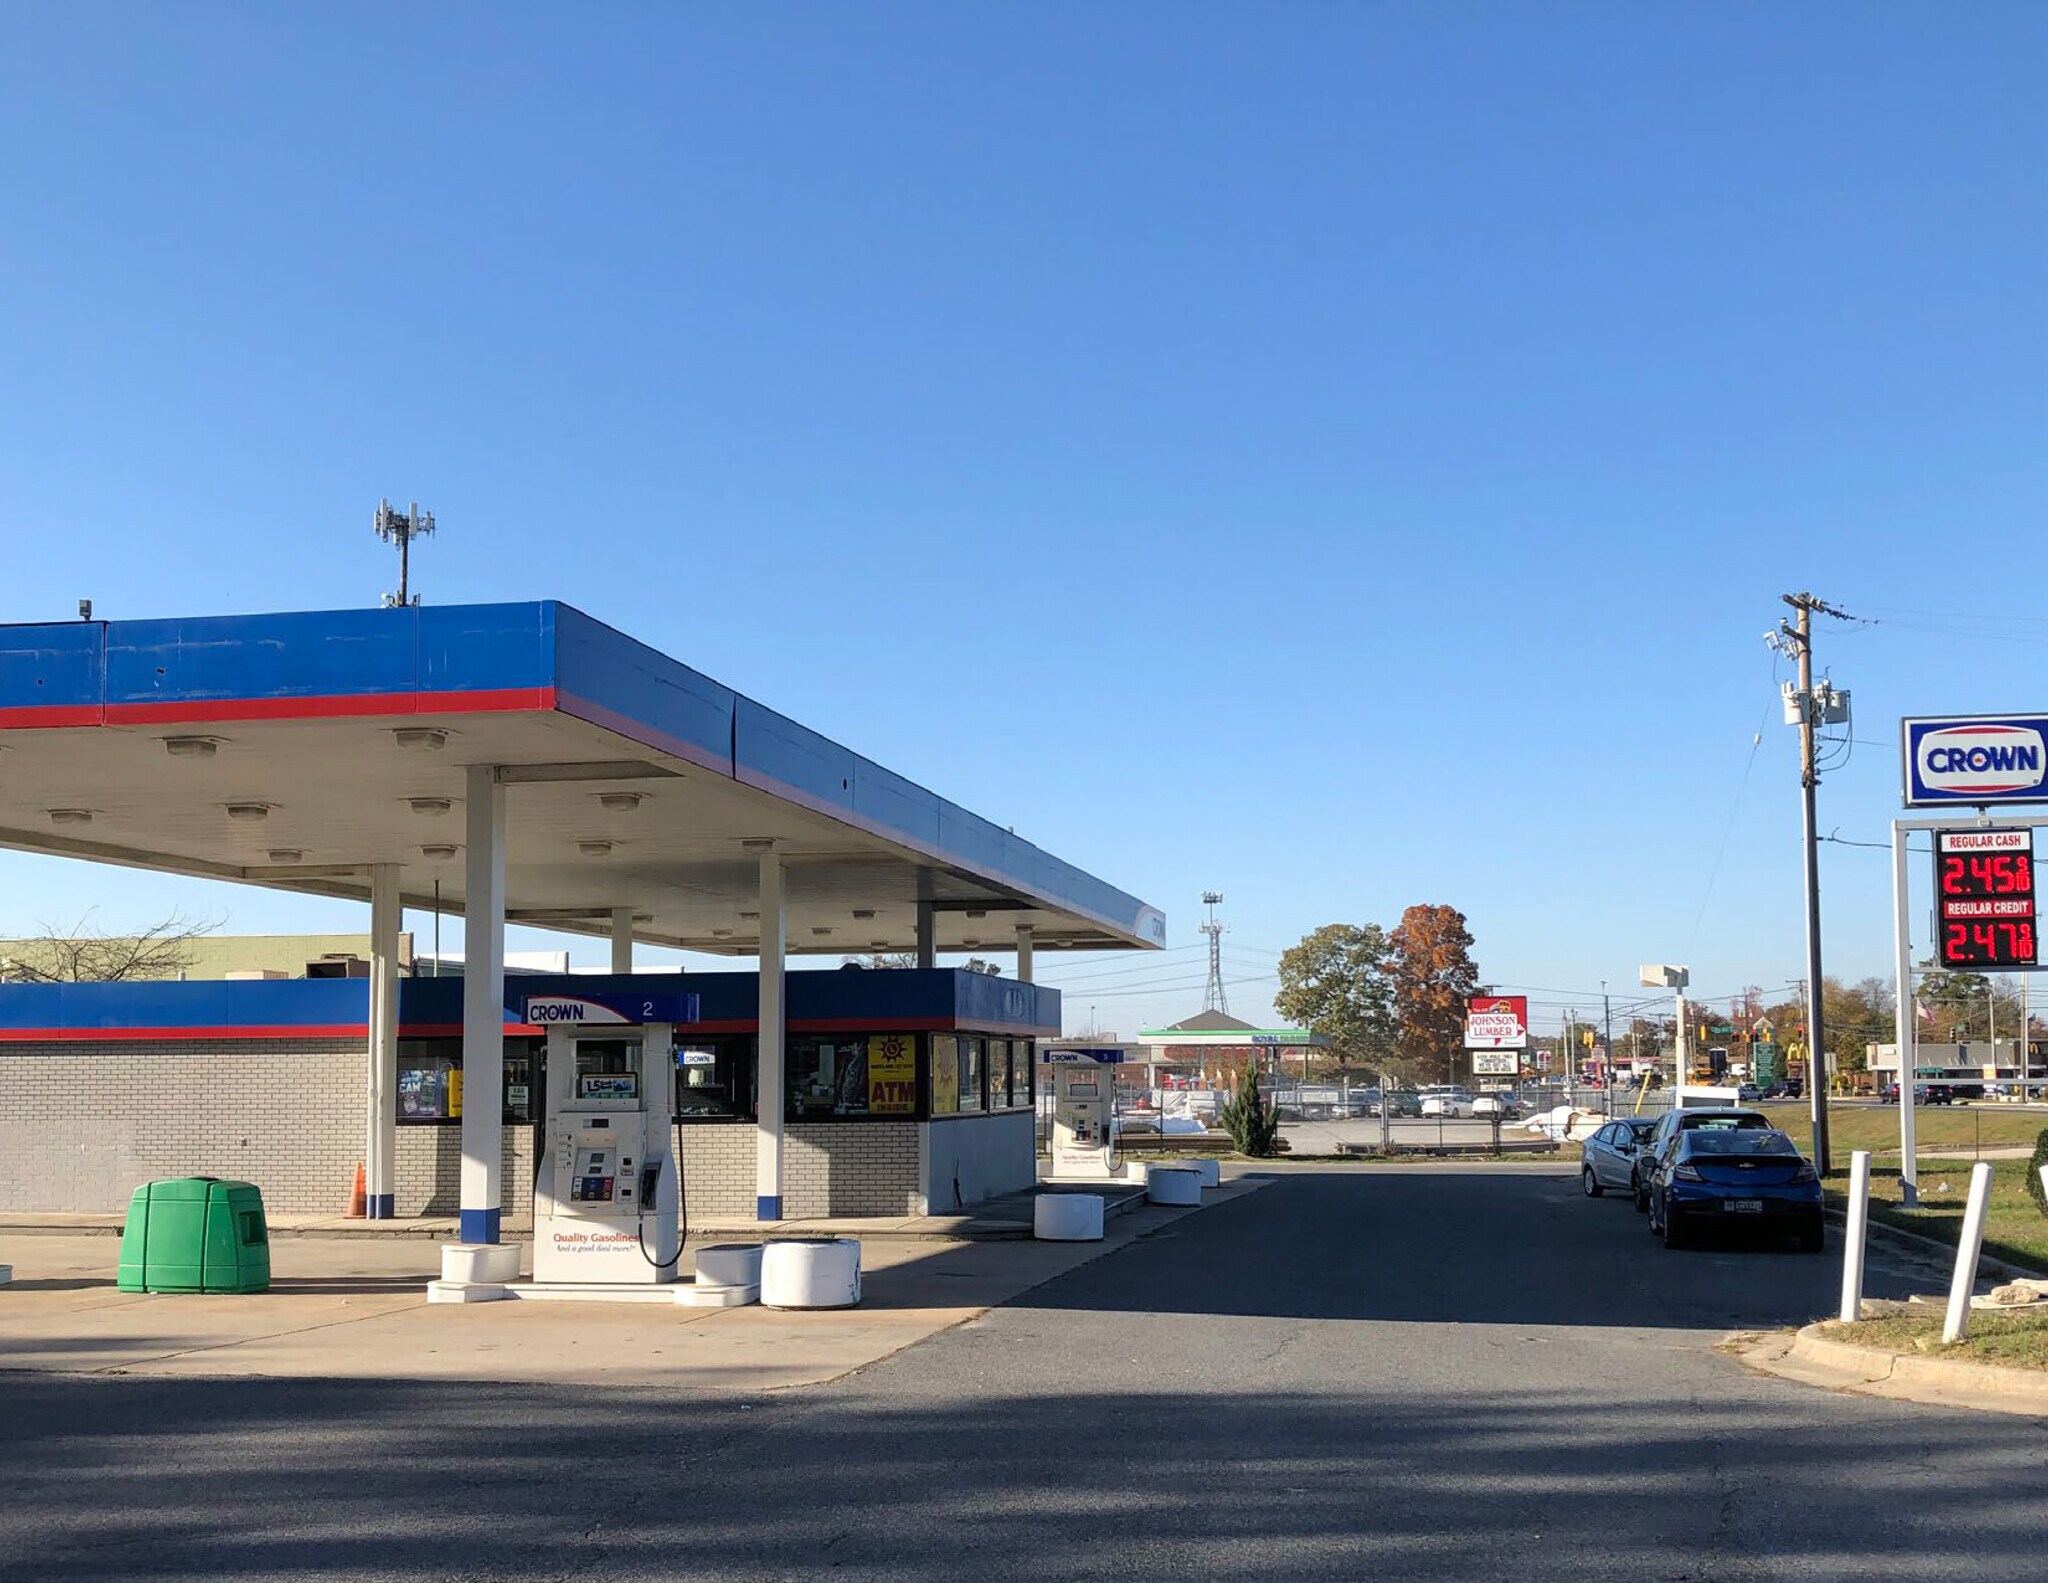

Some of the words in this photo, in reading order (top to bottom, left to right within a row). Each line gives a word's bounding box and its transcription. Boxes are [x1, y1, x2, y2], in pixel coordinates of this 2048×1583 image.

[1926, 745, 2039, 773] CROWN
[1949, 836, 1993, 848] REGULAR
[1995, 835, 2021, 847] CASH
[1948, 902, 1993, 915] REGULAR
[1993, 902, 2028, 914] CREDIT
[530, 1004, 584, 1021] CROWN
[643, 1001, 653, 1016] 2
[1470, 1016, 1516, 1026] JOHNSON
[1474, 1027, 1512, 1036] LUMBER
[685, 1055, 710, 1064] CROWN
[1051, 1054, 1078, 1062] CROWN
[871, 1081, 915, 1102] ATM
[553, 1232, 589, 1244] Quality
[590, 1232, 640, 1243] Gasolines
[577, 1244, 595, 1253] good
[595, 1244, 611, 1252] deal
